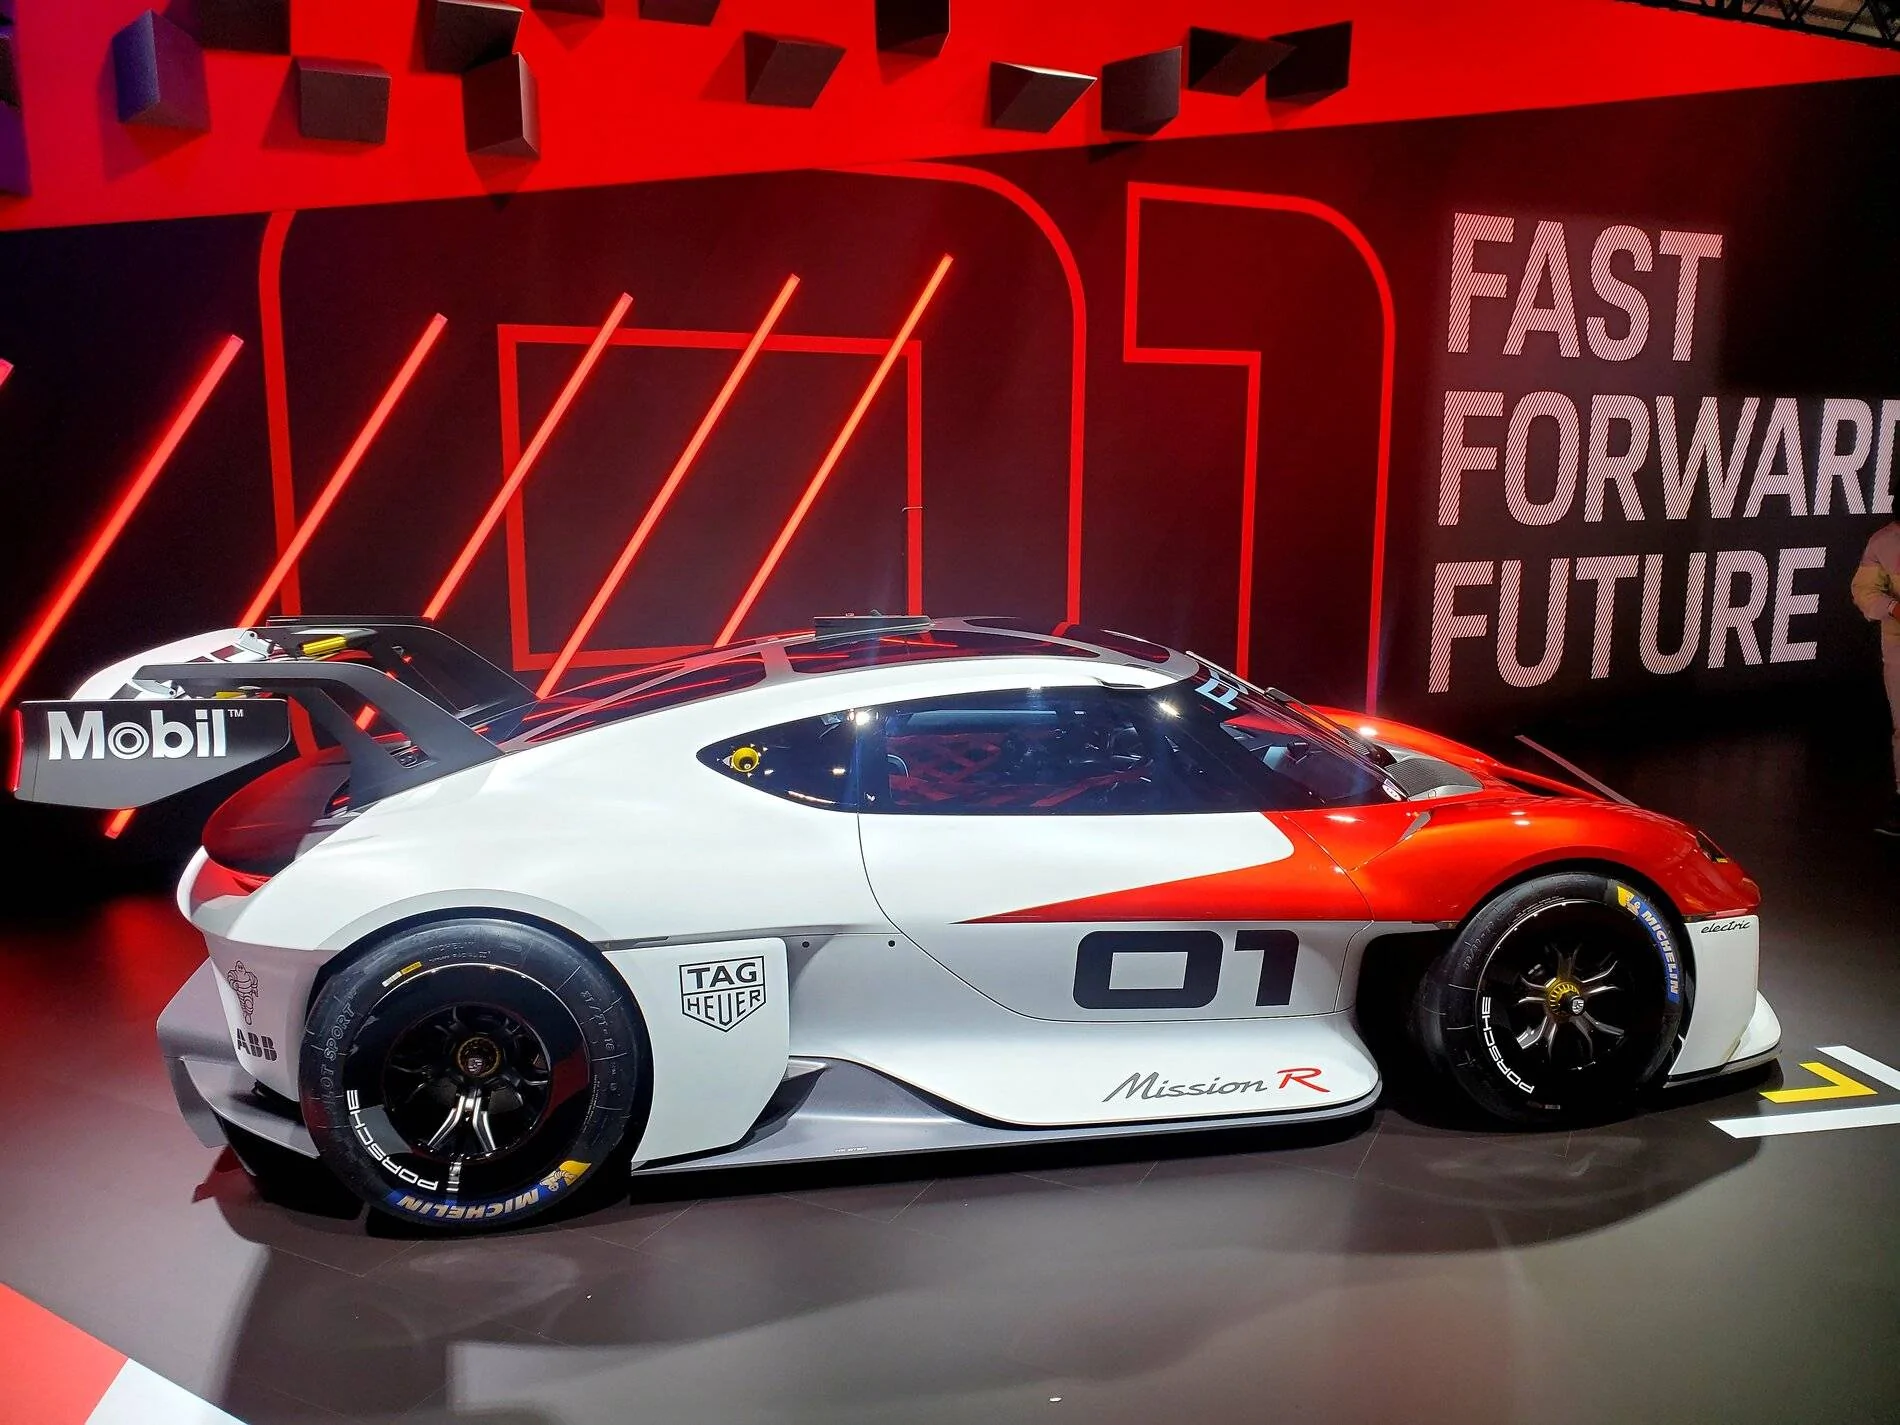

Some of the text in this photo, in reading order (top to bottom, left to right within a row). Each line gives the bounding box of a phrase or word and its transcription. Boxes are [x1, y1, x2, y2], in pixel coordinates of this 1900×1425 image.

[1448, 213, 1723, 362] FAST
[1428, 547, 1826, 693] FUTURE
[1642, 910, 1680, 995] MICHELIN
[1701, 919, 1751, 934] electric
[687, 962, 758, 990] TAG
[1073, 929, 1299, 1010] 01
[323, 1002, 355, 1061] SPORT
[687, 989, 761, 1027] HEUER
[236, 1028, 278, 1062] ABB
[1481, 996, 1536, 1095] PORSCHE
[1101, 1067, 1331, 1103] Mission R
[346, 1089, 439, 1192] PORSCHE
[397, 1187, 540, 1220] MICHELIN
